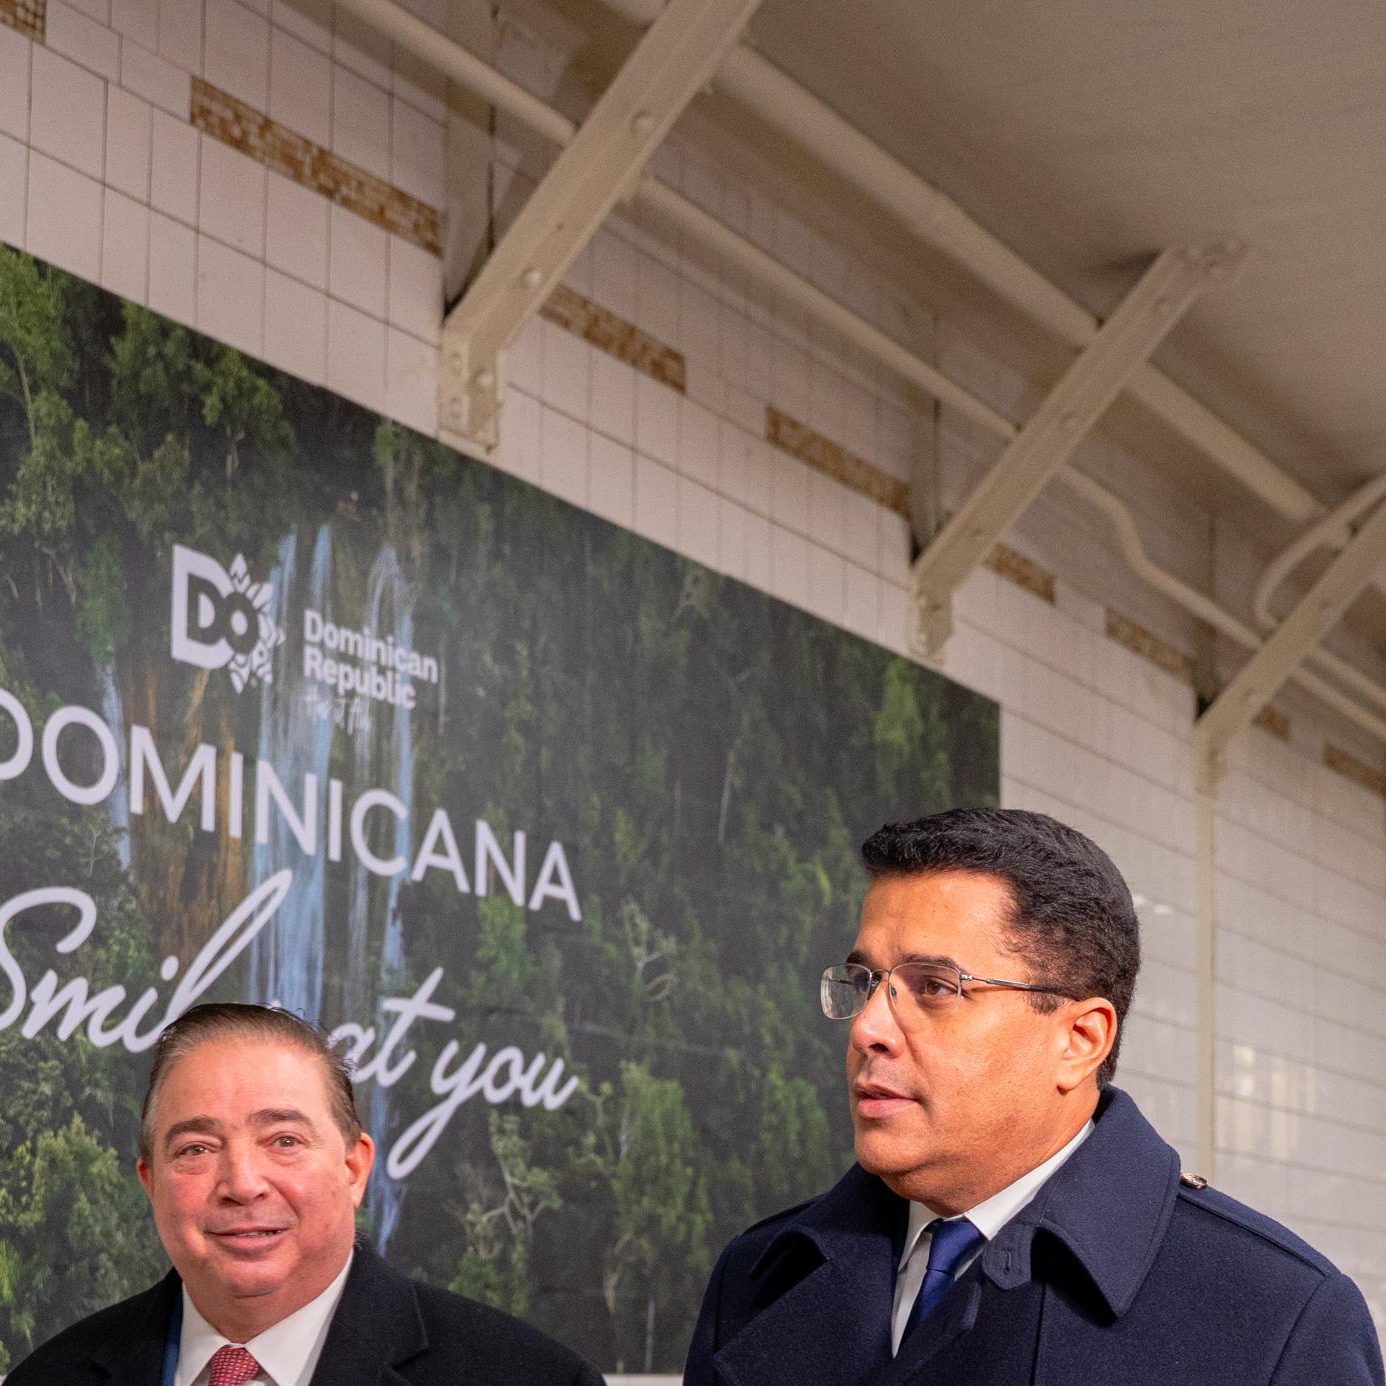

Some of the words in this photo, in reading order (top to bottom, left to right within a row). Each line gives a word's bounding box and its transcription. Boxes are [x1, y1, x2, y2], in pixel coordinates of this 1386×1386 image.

[303, 608, 439, 685] Dominican
[303, 645, 417, 711] Republic
[327, 966, 455, 1087] at
[386, 1037, 581, 1181] you
